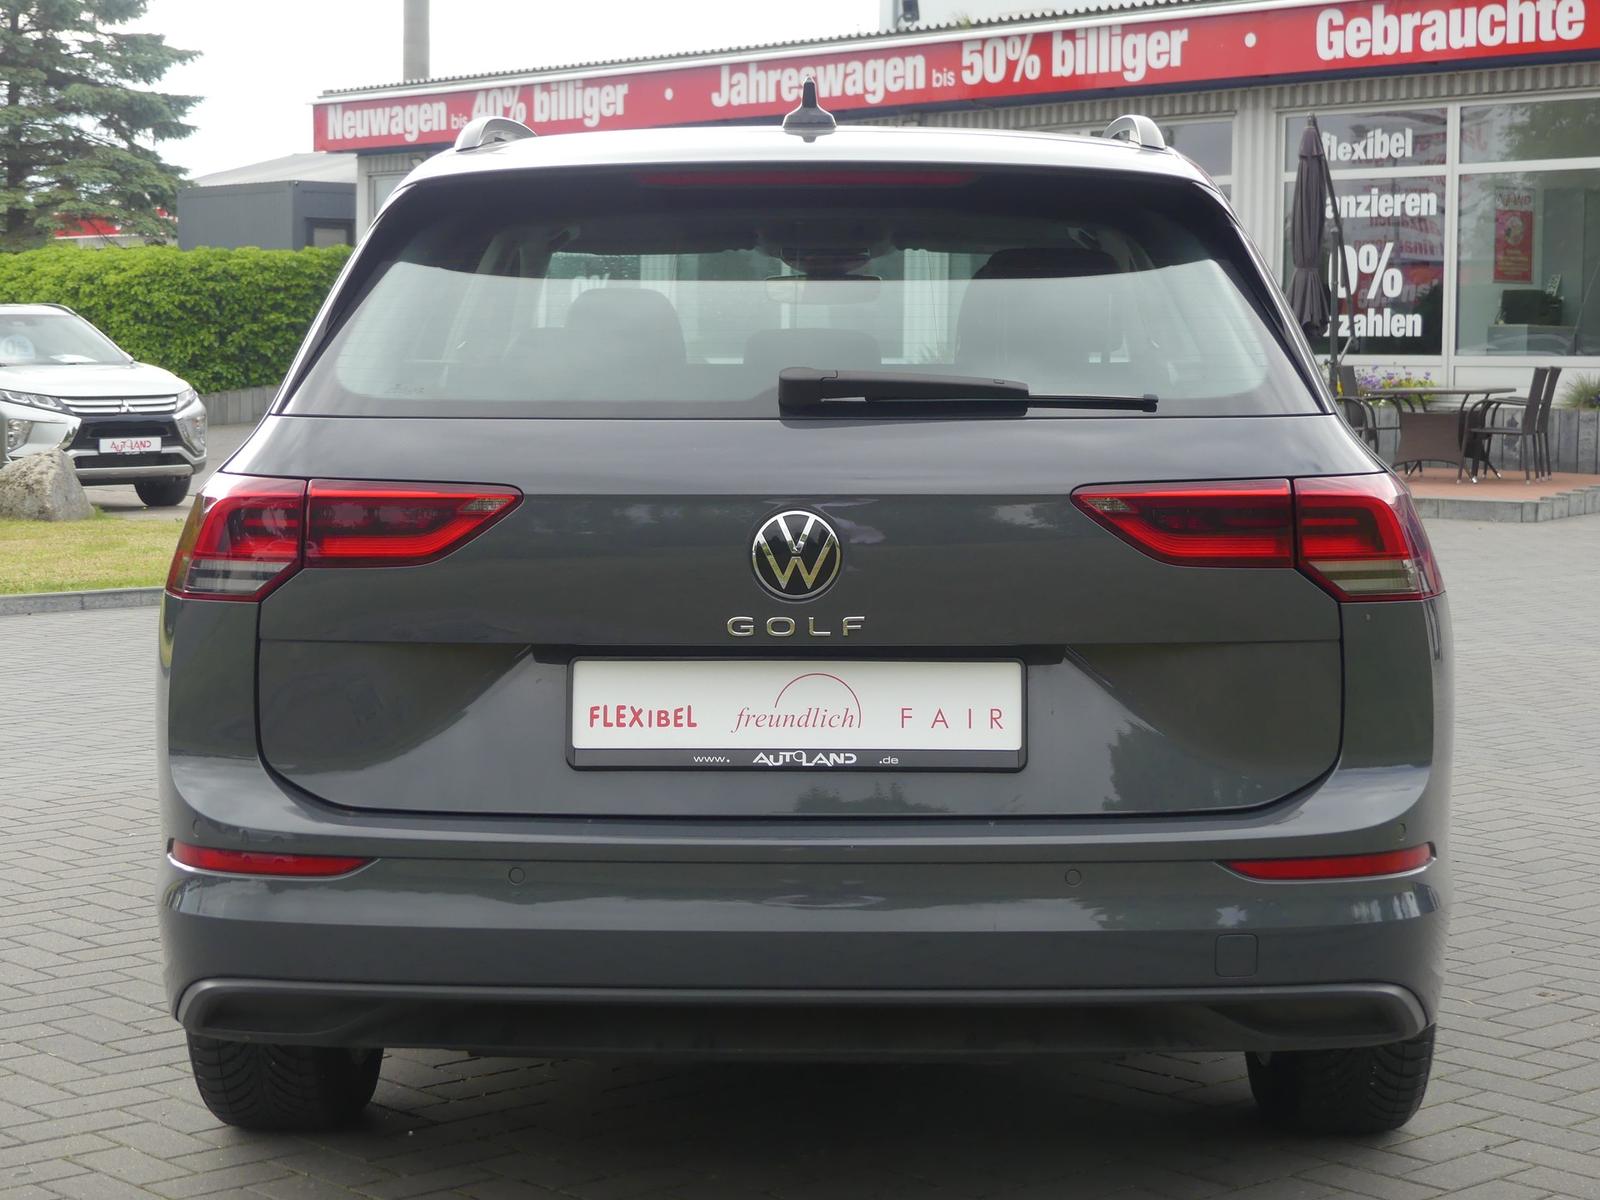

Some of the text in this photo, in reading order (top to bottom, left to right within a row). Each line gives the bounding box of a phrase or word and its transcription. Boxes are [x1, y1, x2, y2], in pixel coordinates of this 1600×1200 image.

[1316, 0, 1586, 61] Gebrauchte
[711, 24, 1189, 107] Jahreswagen bis 50% billiger
[327, 80, 629, 142] Neuwagen bis 40% billiger
[1322, 128, 1413, 161] flexibel
[1323, 308, 1422, 338] zahlen
[753, 510, 841, 600] VW
[726, 615, 867, 638] GOLF
[588, 705, 1005, 734] FLEXIBEL freundlich FAIR
[693, 750, 900, 767] www. AUTOLAND .de
